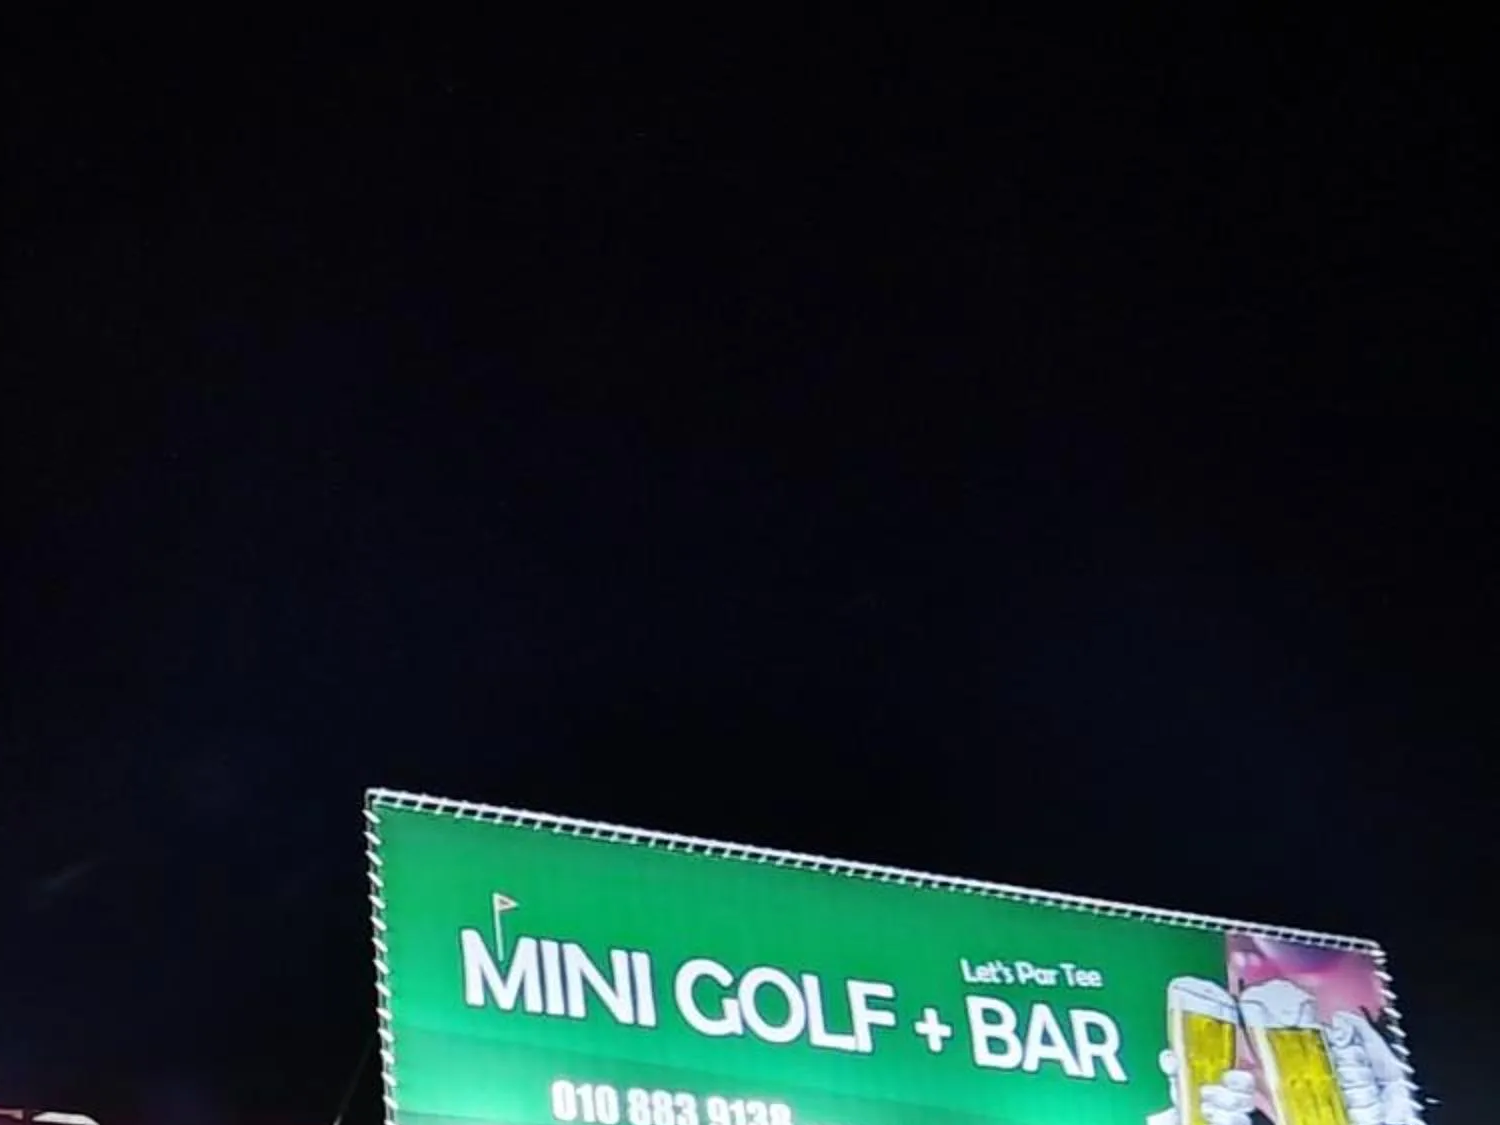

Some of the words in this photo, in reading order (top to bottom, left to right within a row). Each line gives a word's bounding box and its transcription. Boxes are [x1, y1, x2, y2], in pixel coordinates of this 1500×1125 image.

[960, 957, 1014, 984] Let's
[1014, 960, 1058, 985] Par
[1059, 963, 1103, 987] Tee
[460, 929, 656, 1028] MINI
[675, 959, 896, 1053] GOLF
[915, 1008, 952, 1052] +
[965, 994, 1128, 1082] BAR
[552, 1080, 619, 1125] 010
